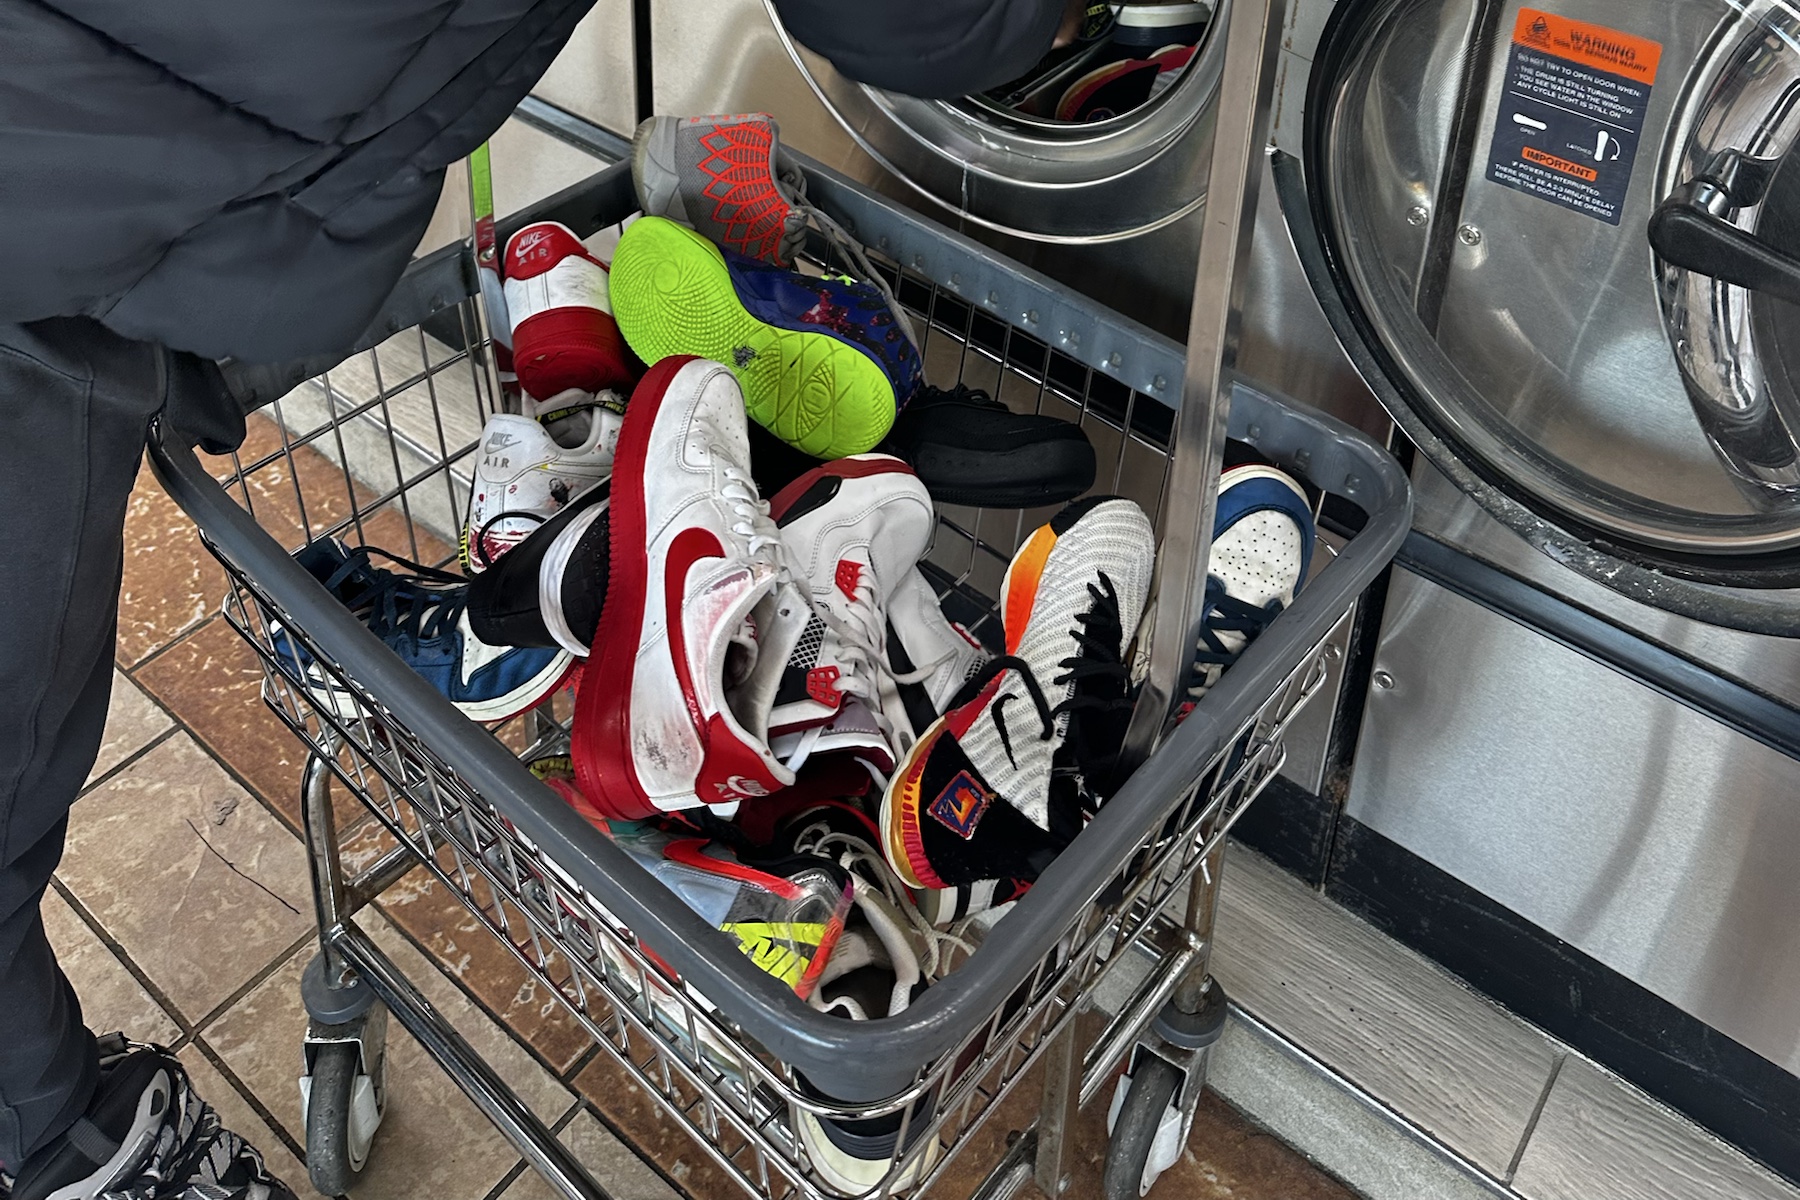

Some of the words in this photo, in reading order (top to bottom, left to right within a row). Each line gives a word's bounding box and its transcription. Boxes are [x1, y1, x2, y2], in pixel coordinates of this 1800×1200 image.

[1570, 30, 1636, 60] WARNING
[1535, 71, 1556, 81] DRUM
[1566, 80, 1585, 91] STILL
[1587, 86, 1619, 102] TURNING
[1562, 67, 1571, 75] TO
[1573, 71, 1593, 82] OPEN
[1594, 78, 1616, 89] DOOR
[1517, 81, 1532, 89] ANY
[1533, 86, 1556, 97] CYCLE
[1558, 94, 1579, 104] LIGHT
[1588, 103, 1608, 114] STILL
[1609, 110, 1621, 118] ON
[1520, 73, 1534, 82] YOU
[1551, 83, 1576, 95] WATER
[1586, 95, 1600, 104] THE
[1602, 100, 1633, 114] WINDOW
[1520, 127, 1536, 135] OPEN
[1519, 163, 1544, 176] POWER
[1527, 150, 1592, 178] IMPORTANT
[1495, 163, 1517, 176] THERE
[1536, 178, 1545, 186] BE
[1564, 188, 1590, 202] MINUTE
[1591, 198, 1615, 210] DELAY
[1495, 171, 1521, 185] BEFORE
[1522, 180, 1536, 190] THE
[1537, 185, 1556, 196] DOOR
[1557, 194, 1572, 203] CAN
[1584, 203, 1612, 217] OPENED
[518, 248, 547, 266] AIR
[483, 455, 509, 468] AIR
